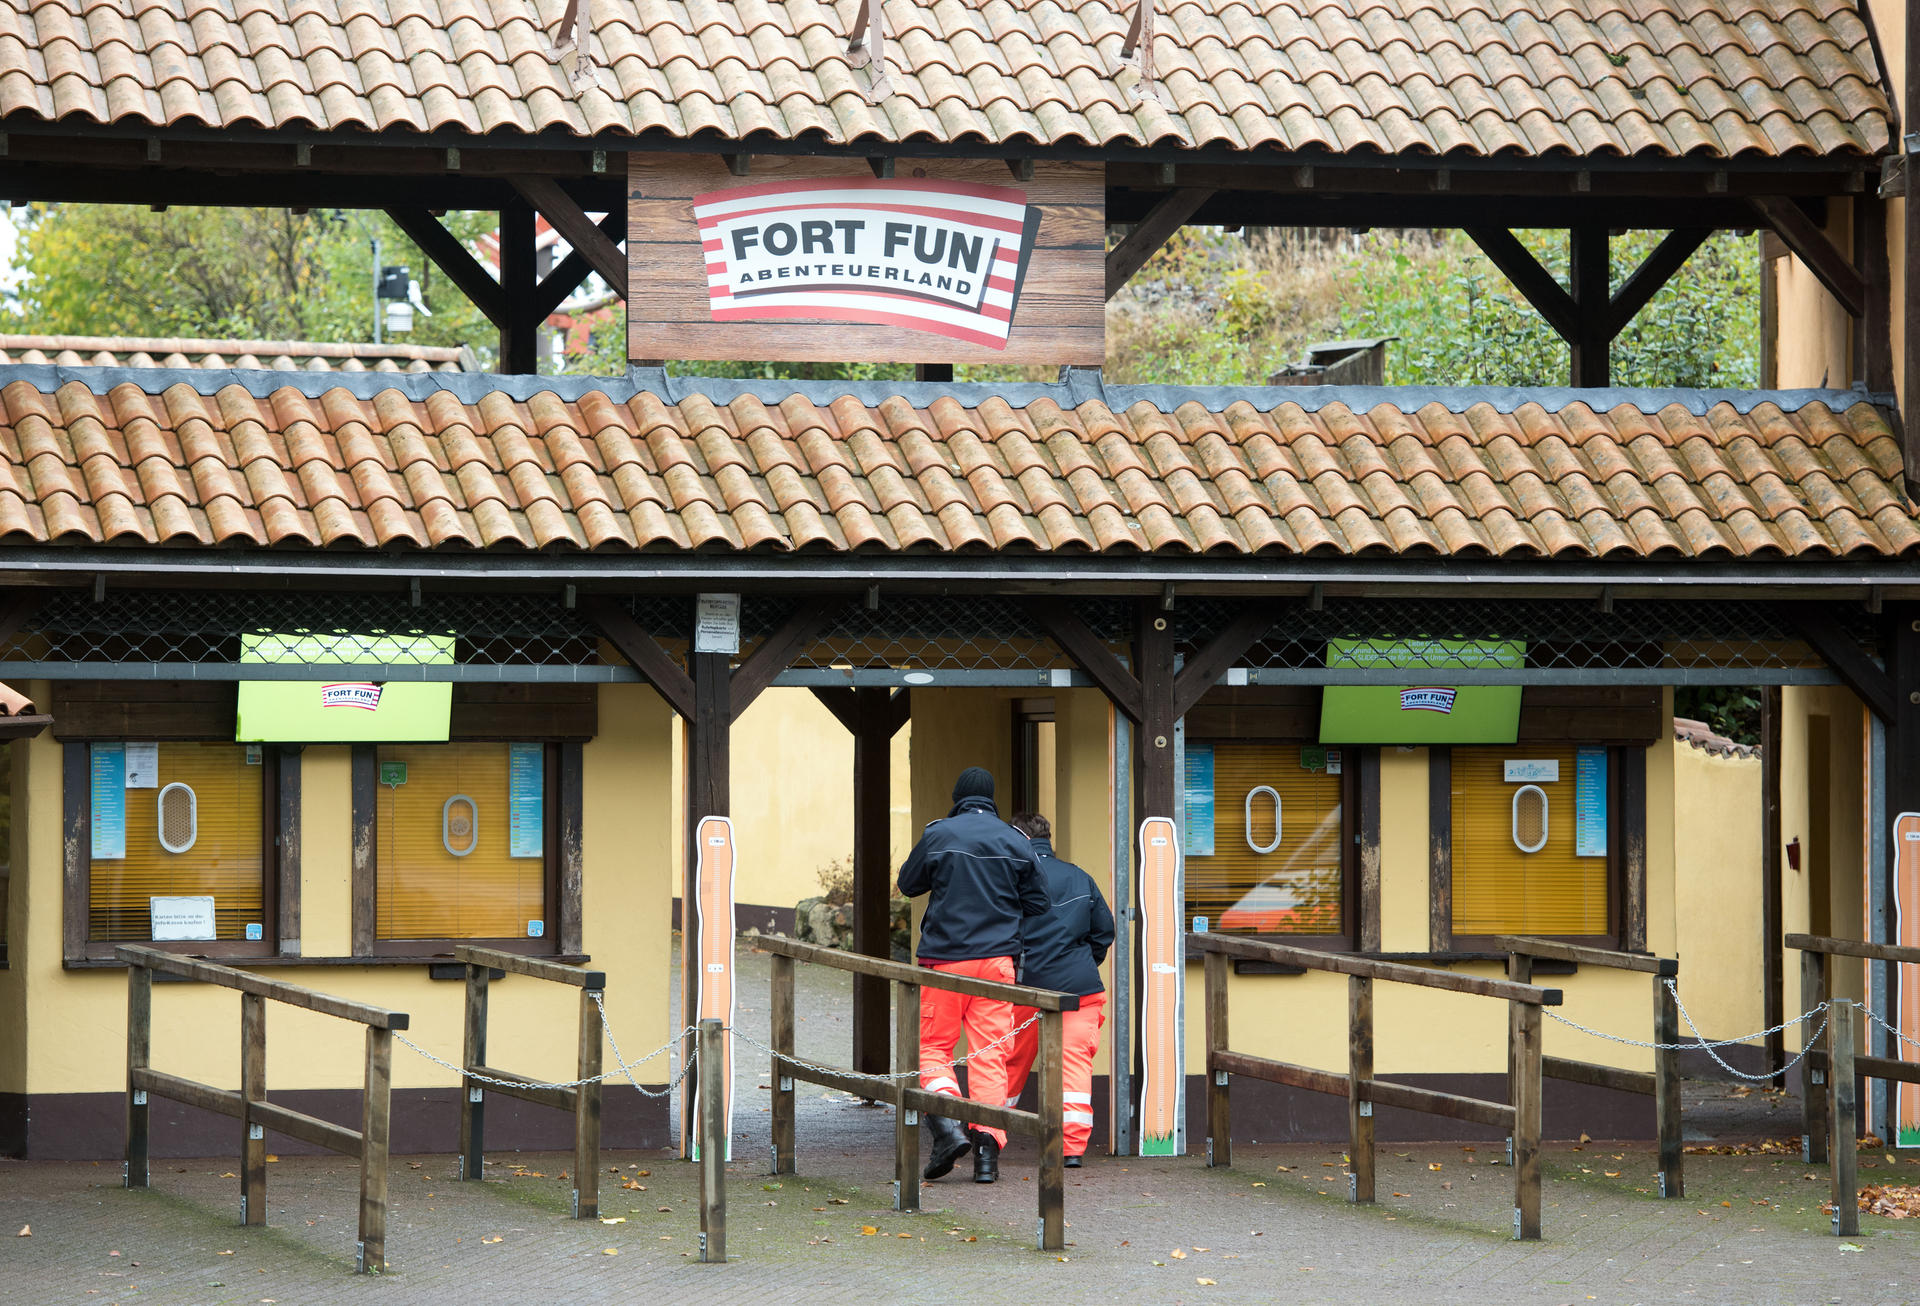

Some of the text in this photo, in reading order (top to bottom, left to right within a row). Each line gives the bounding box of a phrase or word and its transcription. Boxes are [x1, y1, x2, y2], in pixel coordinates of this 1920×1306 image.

[731, 220, 983, 274] FORT FUN
[739, 264, 971, 295] ABENTEUERLAND
[327, 690, 373, 699] FORT FUN
[1405, 693, 1448, 702] FORT FUN
